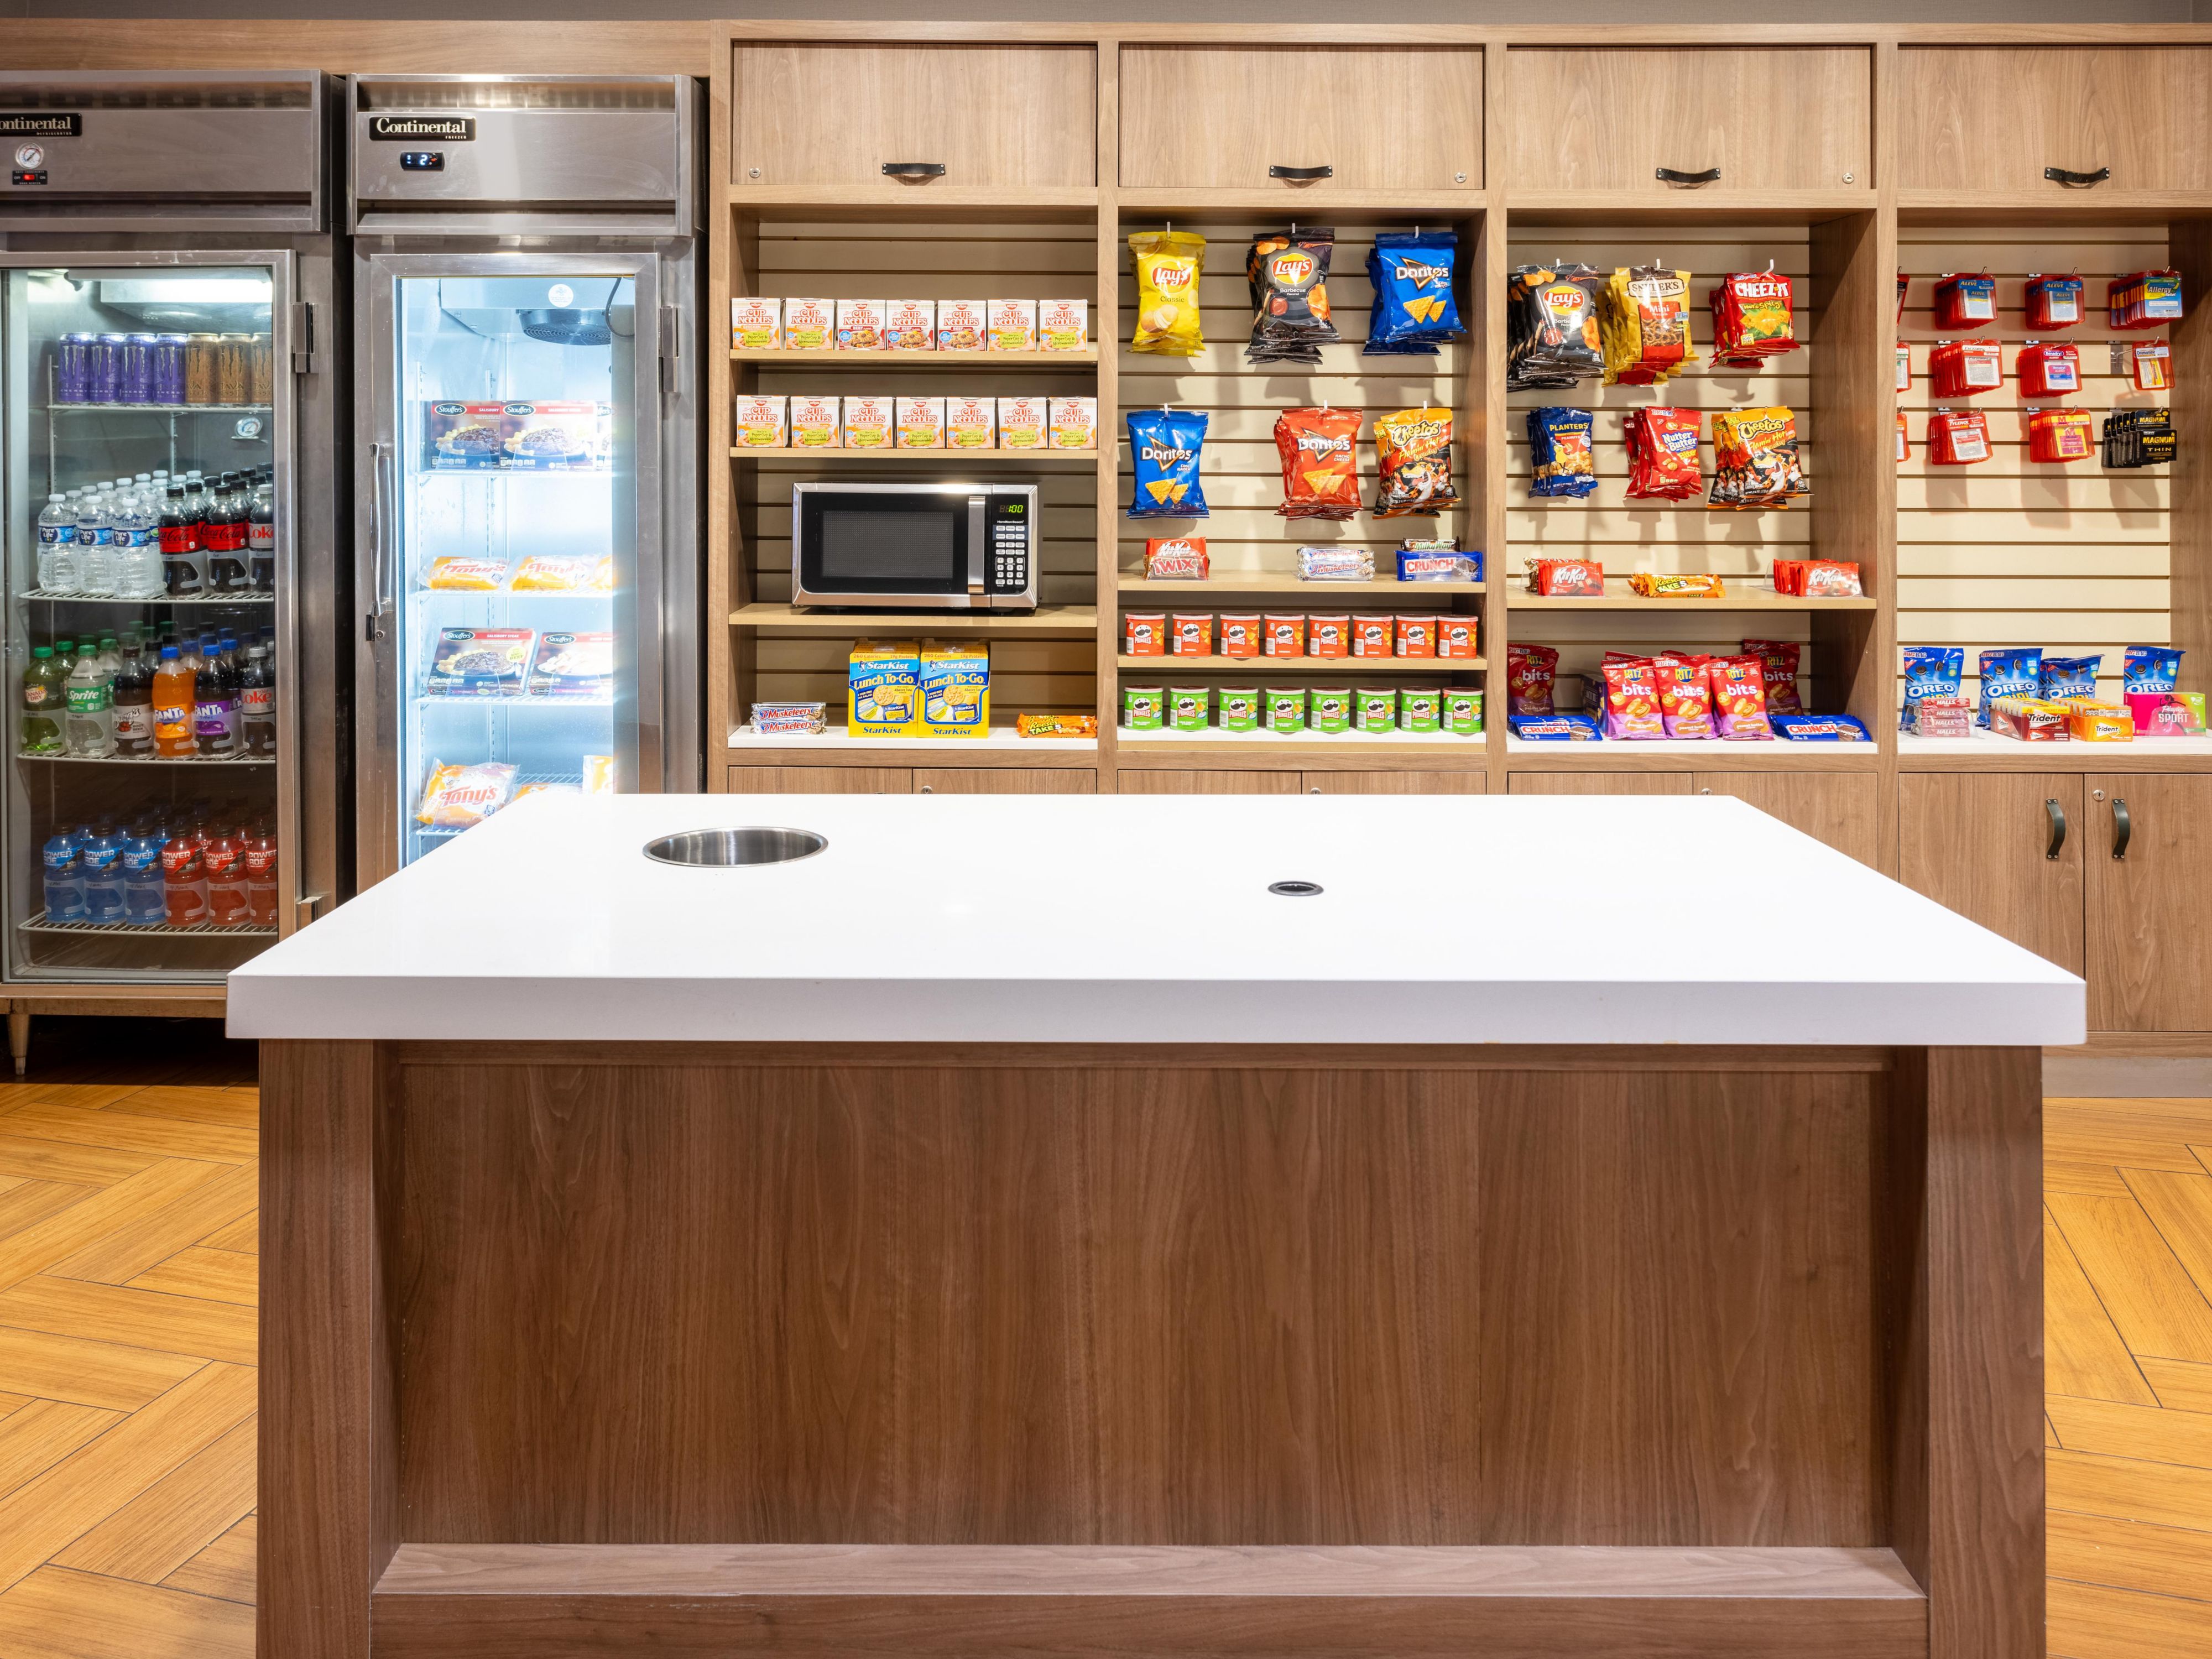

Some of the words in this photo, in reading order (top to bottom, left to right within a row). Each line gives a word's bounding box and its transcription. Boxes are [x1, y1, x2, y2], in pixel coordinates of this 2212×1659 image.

[377, 117, 466, 133] Continental
[1275, 259, 1310, 276] Lay's
[1155, 267, 1190, 286] Lay's
[1396, 267, 1449, 280] Doritos
[1547, 291, 1582, 307] Lay's
[1759, 300, 1780, 310] Spicy
[738, 316, 773, 324] NOODLES
[952, 310, 972, 319] CUP
[944, 317, 979, 326] NOODLES
[742, 414, 778, 422] NOODLES
[1055, 415, 1090, 424] NOODLES
[1550, 422, 1588, 431] PLANTERS
[1739, 419, 1783, 439] Cheetos
[1394, 421, 1439, 446] Cheetos
[1662, 432, 1693, 442] Nutter
[1772, 431, 1786, 441] Hot
[1298, 439, 1350, 451] Doritos
[1668, 437, 1698, 451] Butter
[1141, 447, 1193, 460] Doritos
[1009, 505, 1023, 513] 1:00
[443, 564, 506, 575] Tony's
[1310, 564, 1318, 575] 3
[1318, 563, 1361, 574] Musketeers
[1406, 559, 1455, 572] CRUNCH
[1657, 583, 1679, 593] TAKE
[1451, 639, 1468, 647] PRINGLES
[867, 661, 909, 670] StarKist
[938, 661, 979, 670] StarKist
[1767, 656, 1785, 666] RITZ
[1624, 669, 1644, 679] RITZ
[1674, 667, 1695, 680] RITZ
[1726, 668, 1746, 679] RITZ
[1764, 671, 1793, 681] bits
[854, 675, 884, 690] Lunch
[924, 675, 954, 690] Lunch
[2126, 684, 2173, 692] OREO
[1621, 684, 1651, 696] bits
[1672, 685, 1705, 697] bits
[1726, 684, 1757, 696] bits
[1908, 684, 1954, 697] OREO
[1987, 683, 2036, 696] OREO
[2048, 685, 2095, 698] OREO
[69, 690, 99, 701] Sprite
[761, 710, 768, 719] 3
[768, 708, 811, 718] Musketeers
[1453, 711, 1471, 720] PRINGLES
[2158, 713, 2188, 722] SPORT
[1030, 726, 1054, 735] TAKE
[1789, 725, 1836, 733] CRUNCH
[440, 785, 497, 806] Tony's
